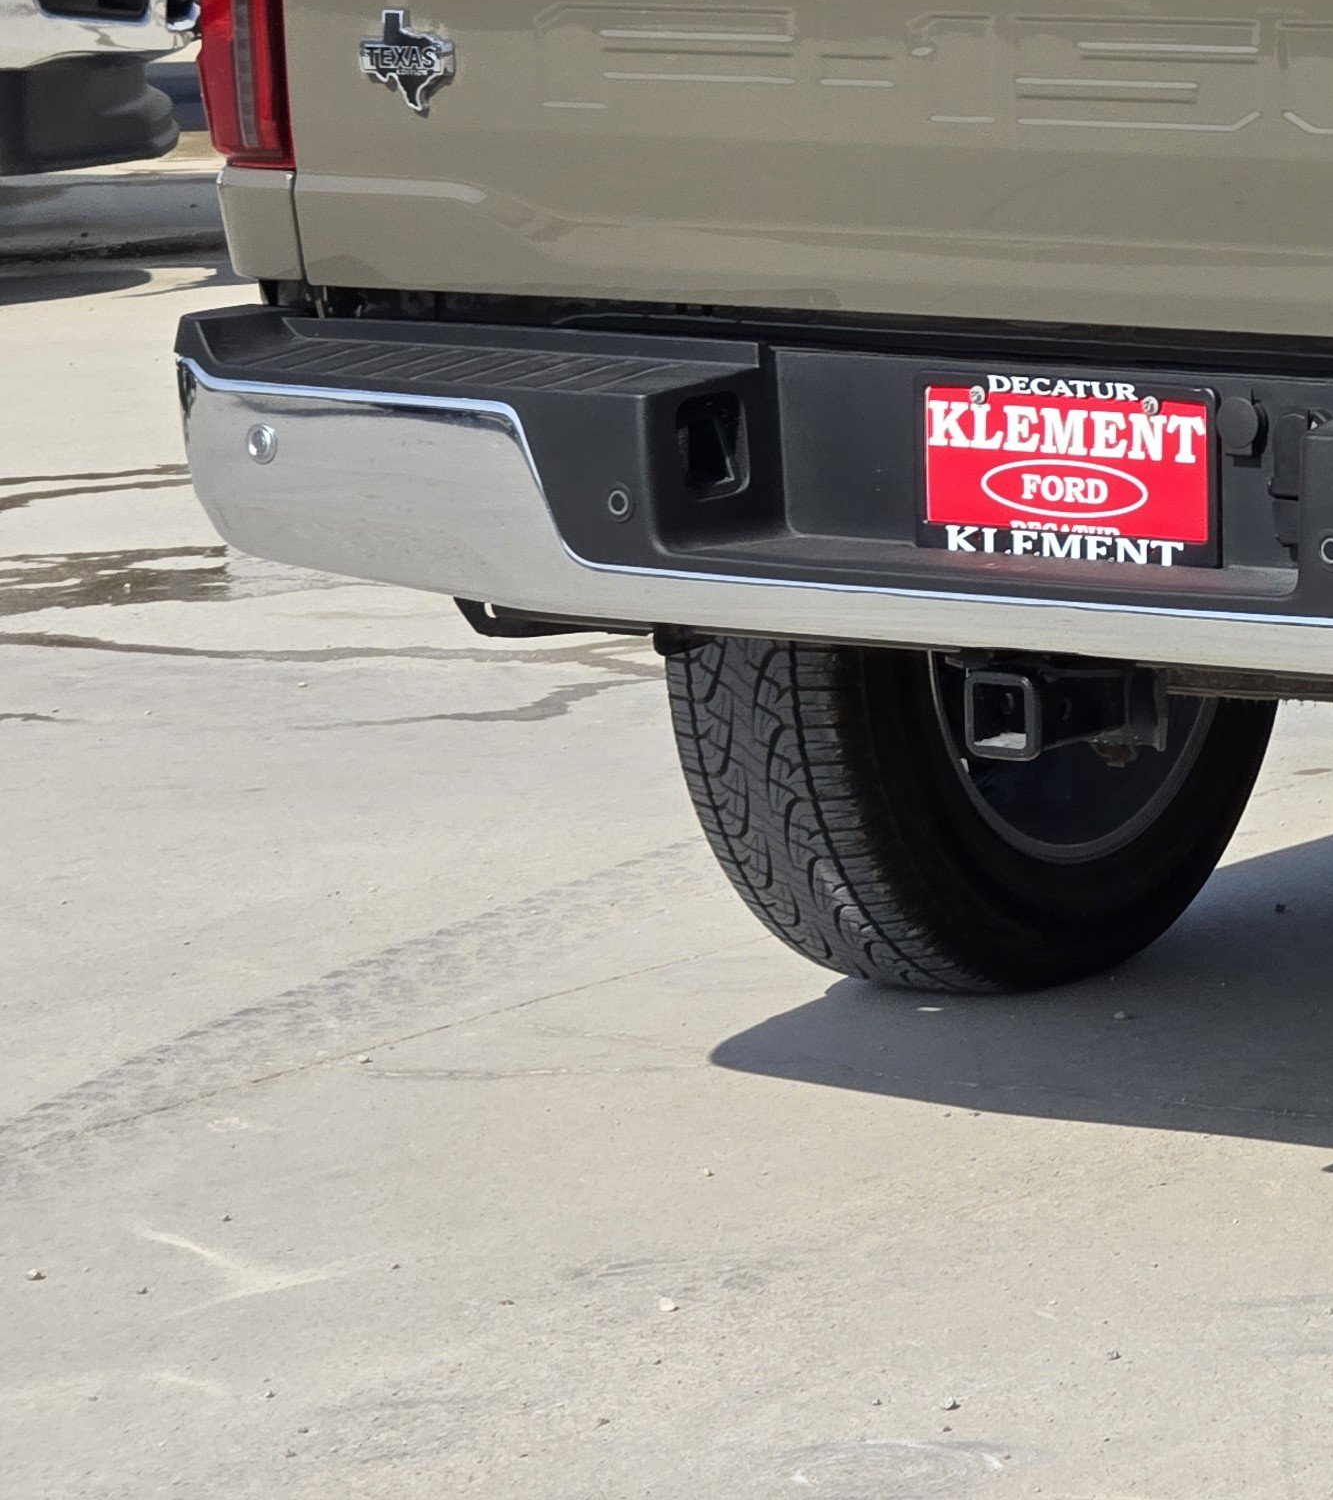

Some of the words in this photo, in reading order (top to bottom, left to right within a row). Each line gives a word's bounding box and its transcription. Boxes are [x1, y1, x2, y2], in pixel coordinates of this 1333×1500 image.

[363, 45, 436, 69] TEXAS
[987, 374, 1138, 402] DECATUR
[928, 400, 1207, 464] KLEMENT
[1021, 473, 1109, 505] FORD
[945, 524, 1184, 567] KLEMENT
